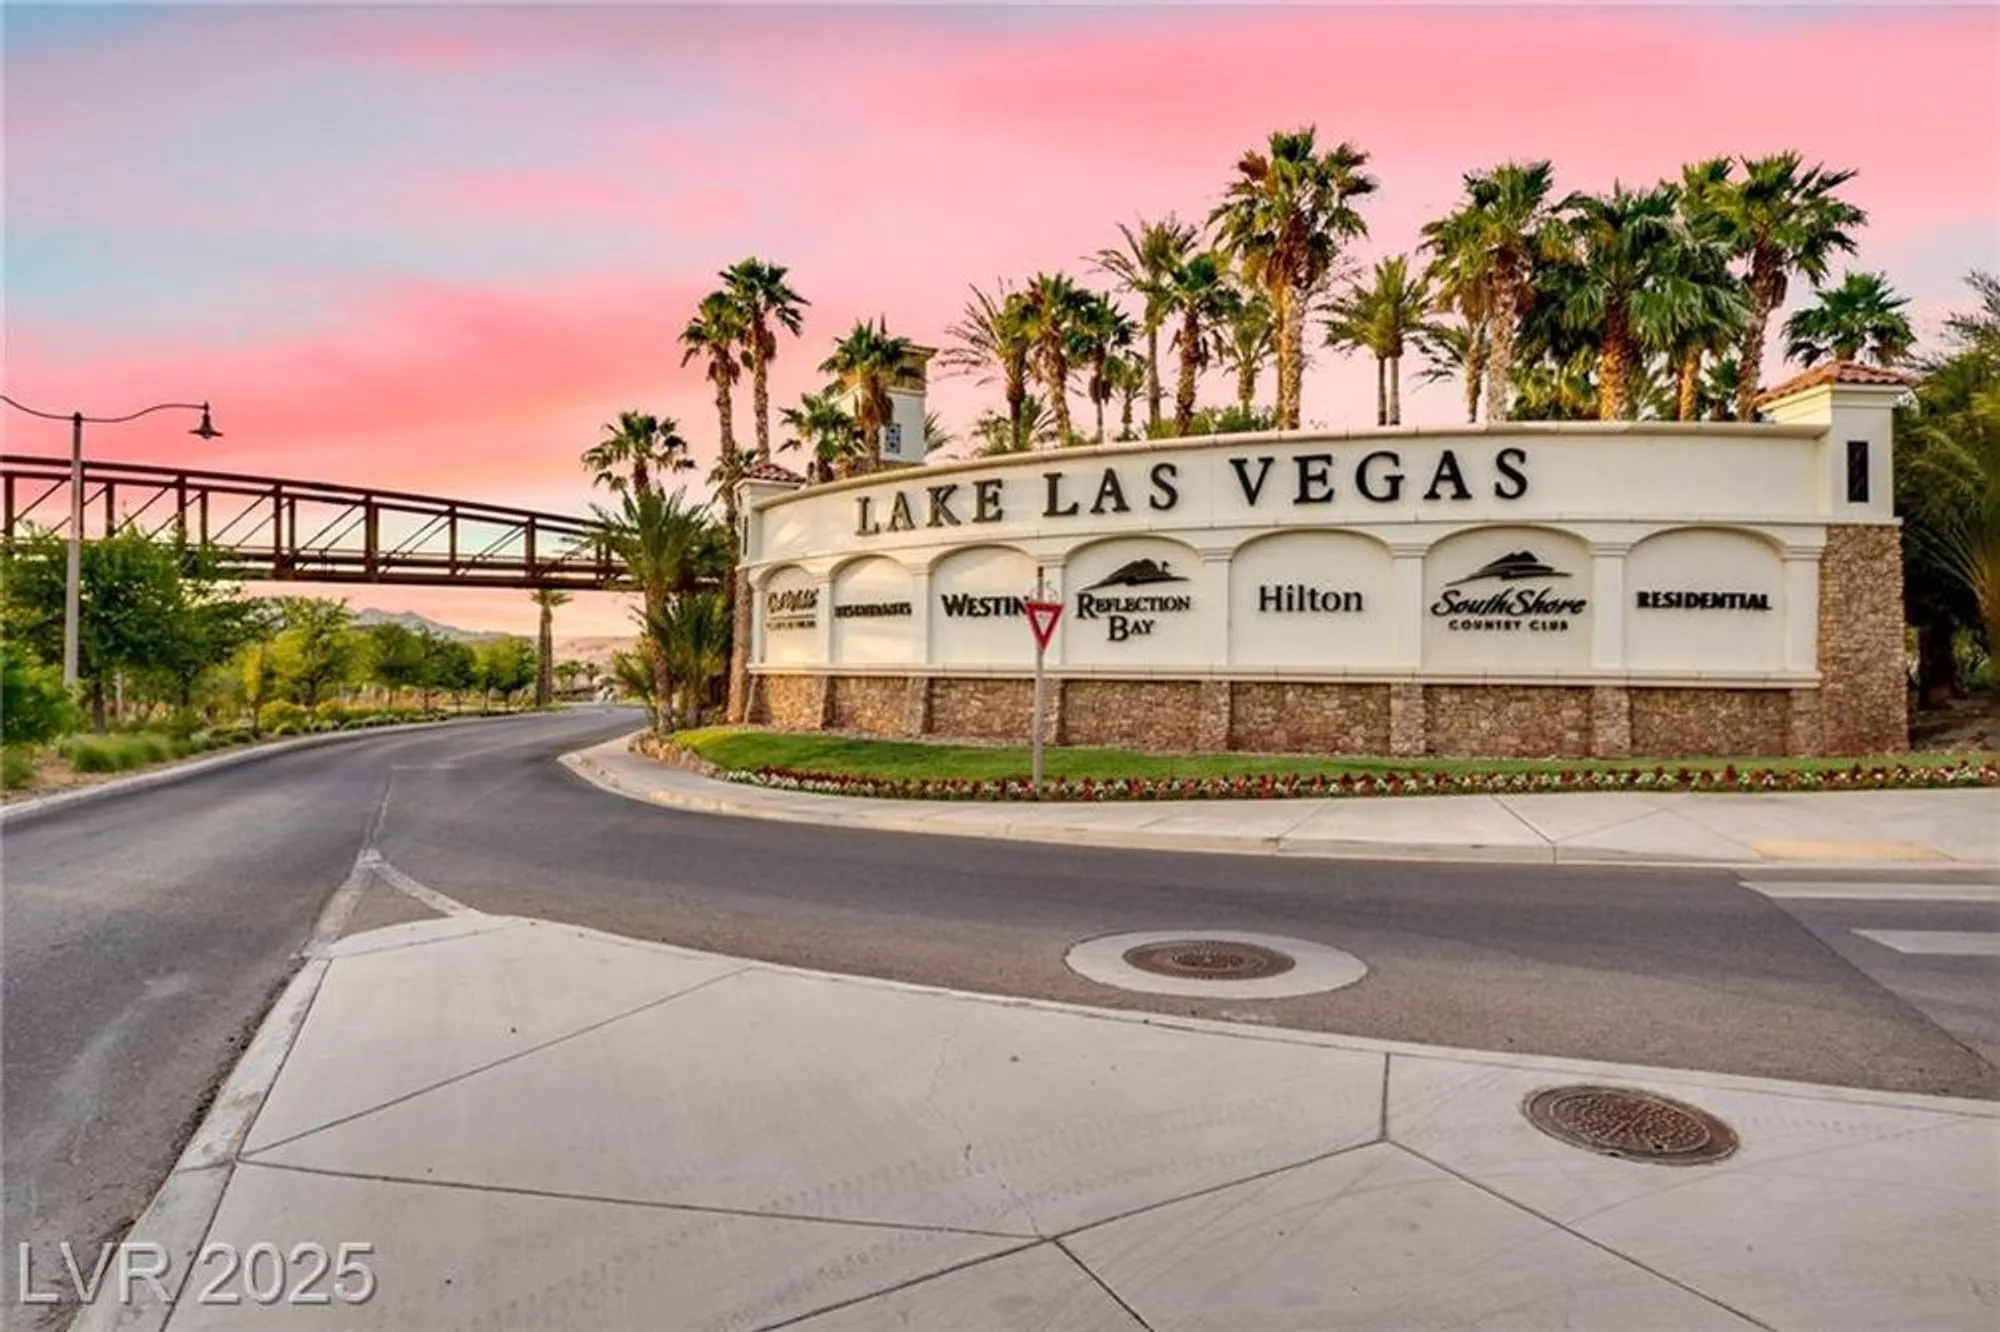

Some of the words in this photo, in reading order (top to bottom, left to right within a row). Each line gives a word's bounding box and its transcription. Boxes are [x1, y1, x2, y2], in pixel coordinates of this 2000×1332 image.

[855, 479, 1004, 536] LAKE
[1043, 462, 1179, 518] LAS
[1228, 447, 1529, 506] VEGAS
[1076, 592, 1191, 619] REFLECTION
[1258, 584, 1364, 613] Hilton
[1636, 591, 1773, 611] RESIDENTIAL
[1107, 614, 1155, 642] BAY
[1447, 619, 1522, 632] COUNTRY
[1528, 619, 1570, 632] CLUB
